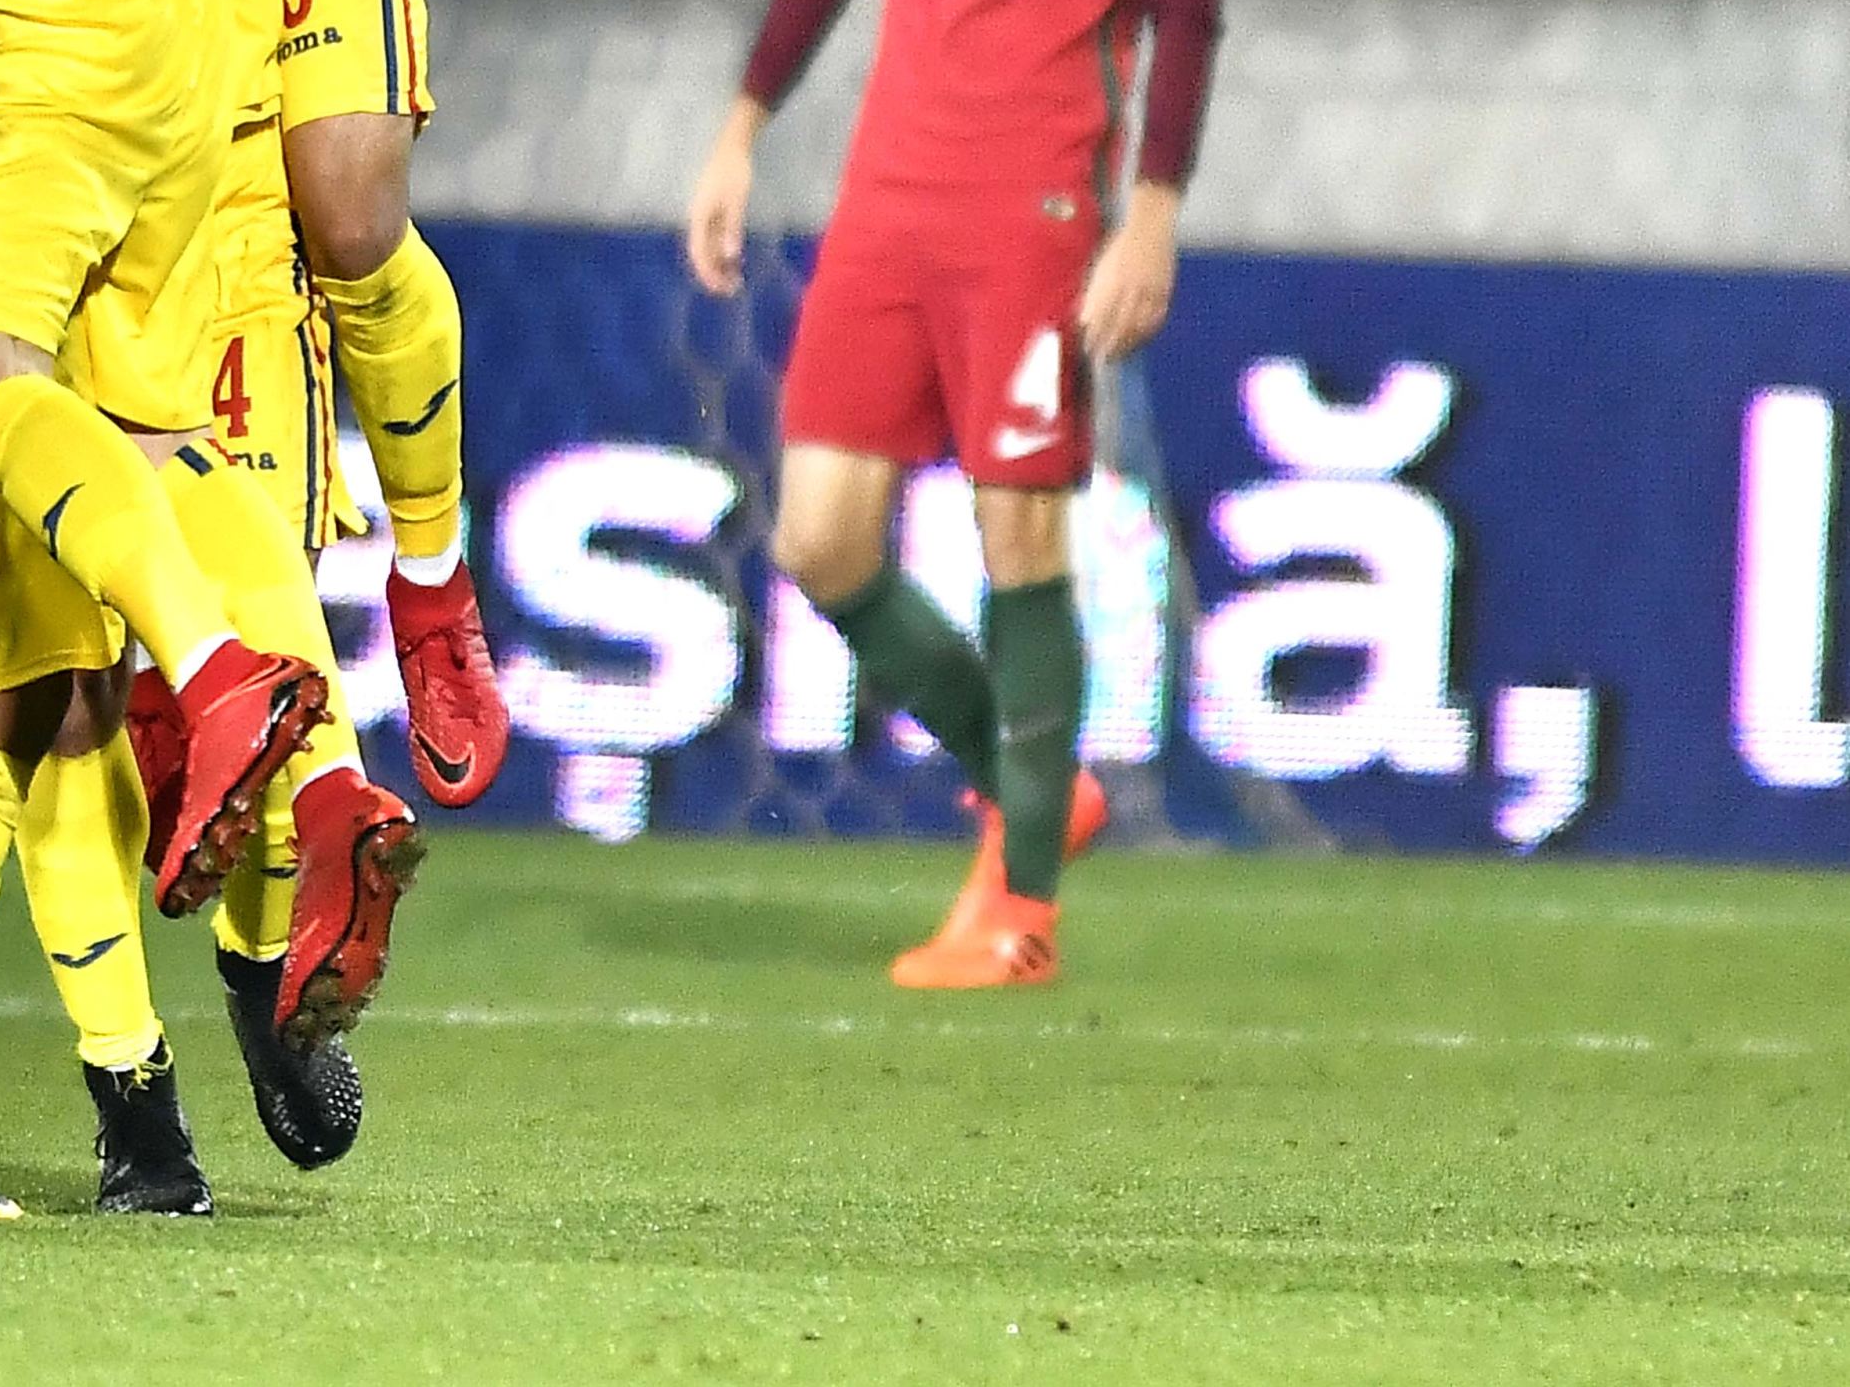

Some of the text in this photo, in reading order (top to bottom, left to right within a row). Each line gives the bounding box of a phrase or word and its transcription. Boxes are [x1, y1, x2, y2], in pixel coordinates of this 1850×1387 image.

[276, 27, 343, 68] oma
[213, 336, 251, 438] 4
[1010, 329, 1061, 420] 4
